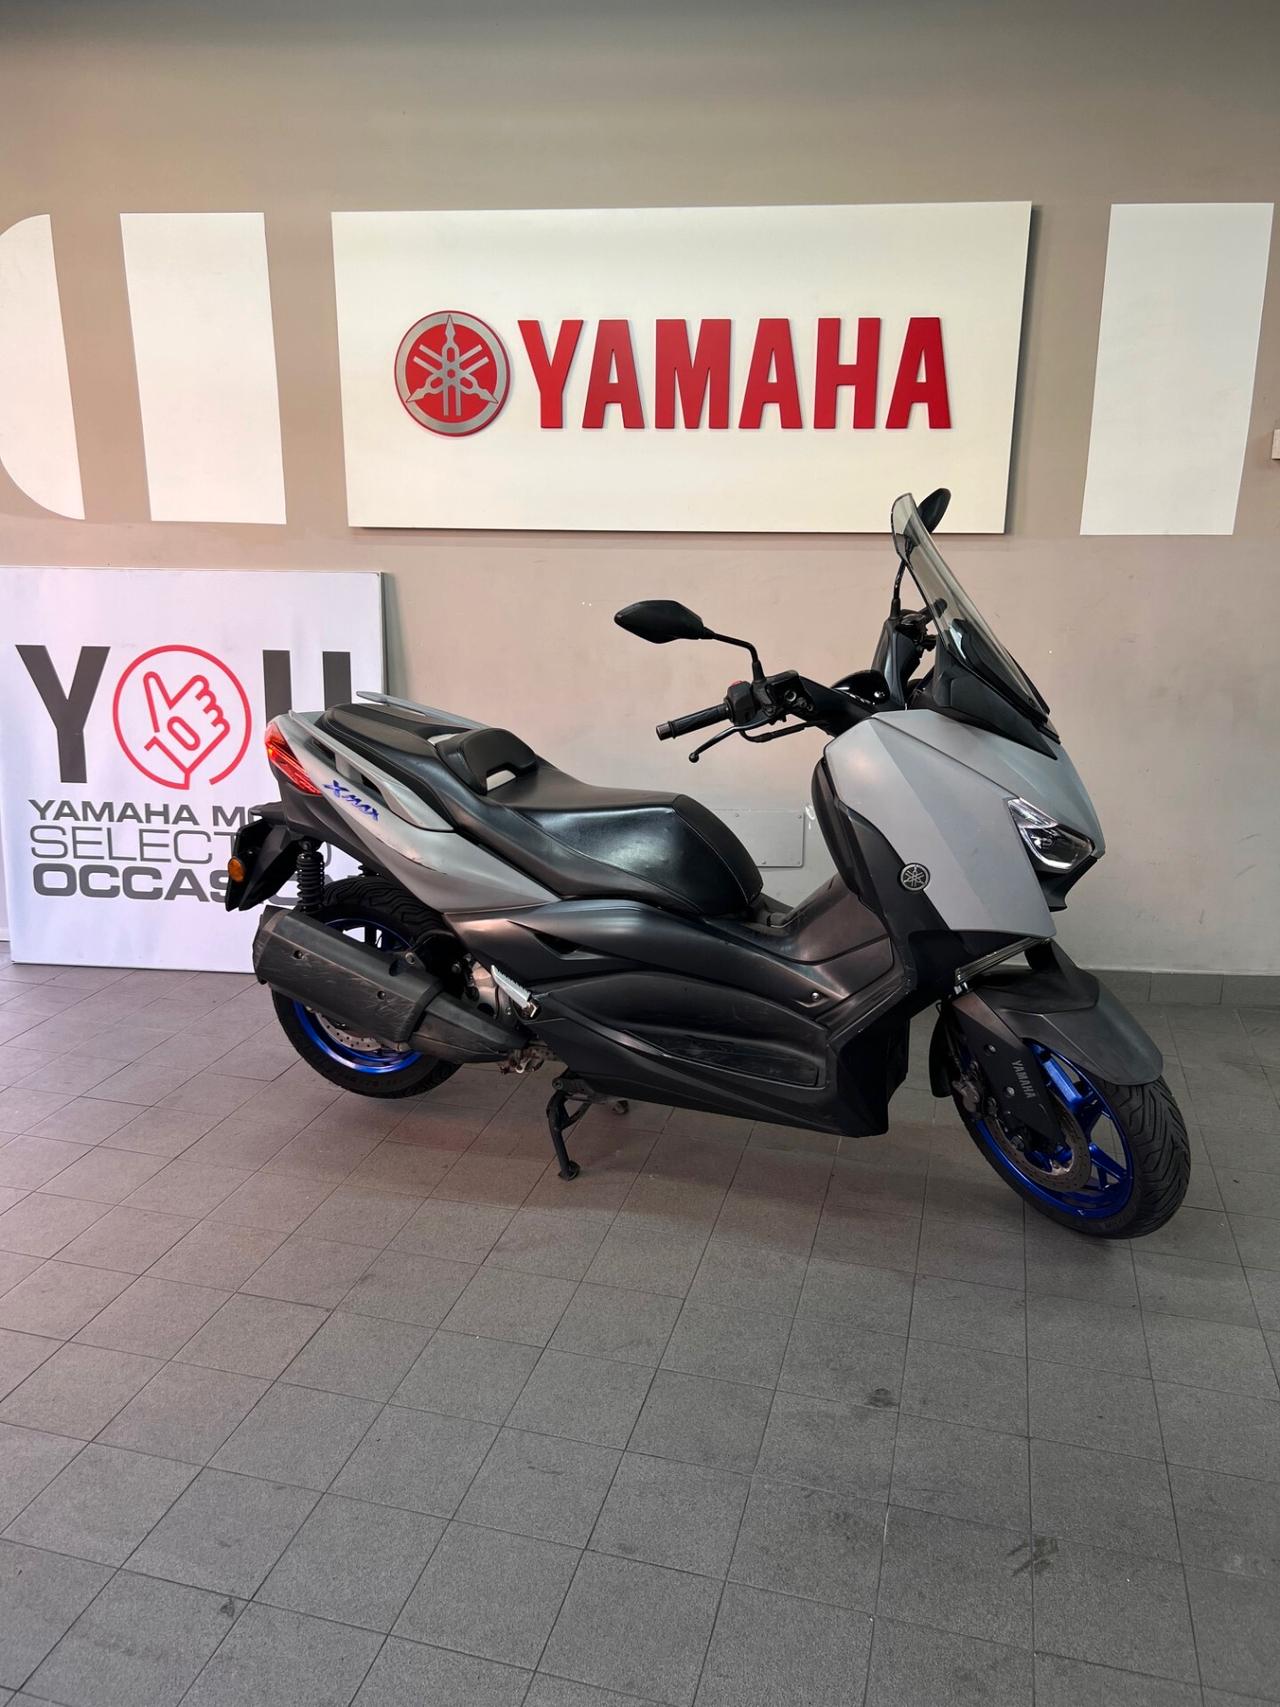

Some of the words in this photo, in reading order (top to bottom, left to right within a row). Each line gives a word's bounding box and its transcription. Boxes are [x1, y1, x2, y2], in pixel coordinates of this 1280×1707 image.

[518, 317, 951, 430] YAMAHA
[28, 799, 200, 825] YAMAHA
[1012, 1060, 1036, 1098] YAMAHA
